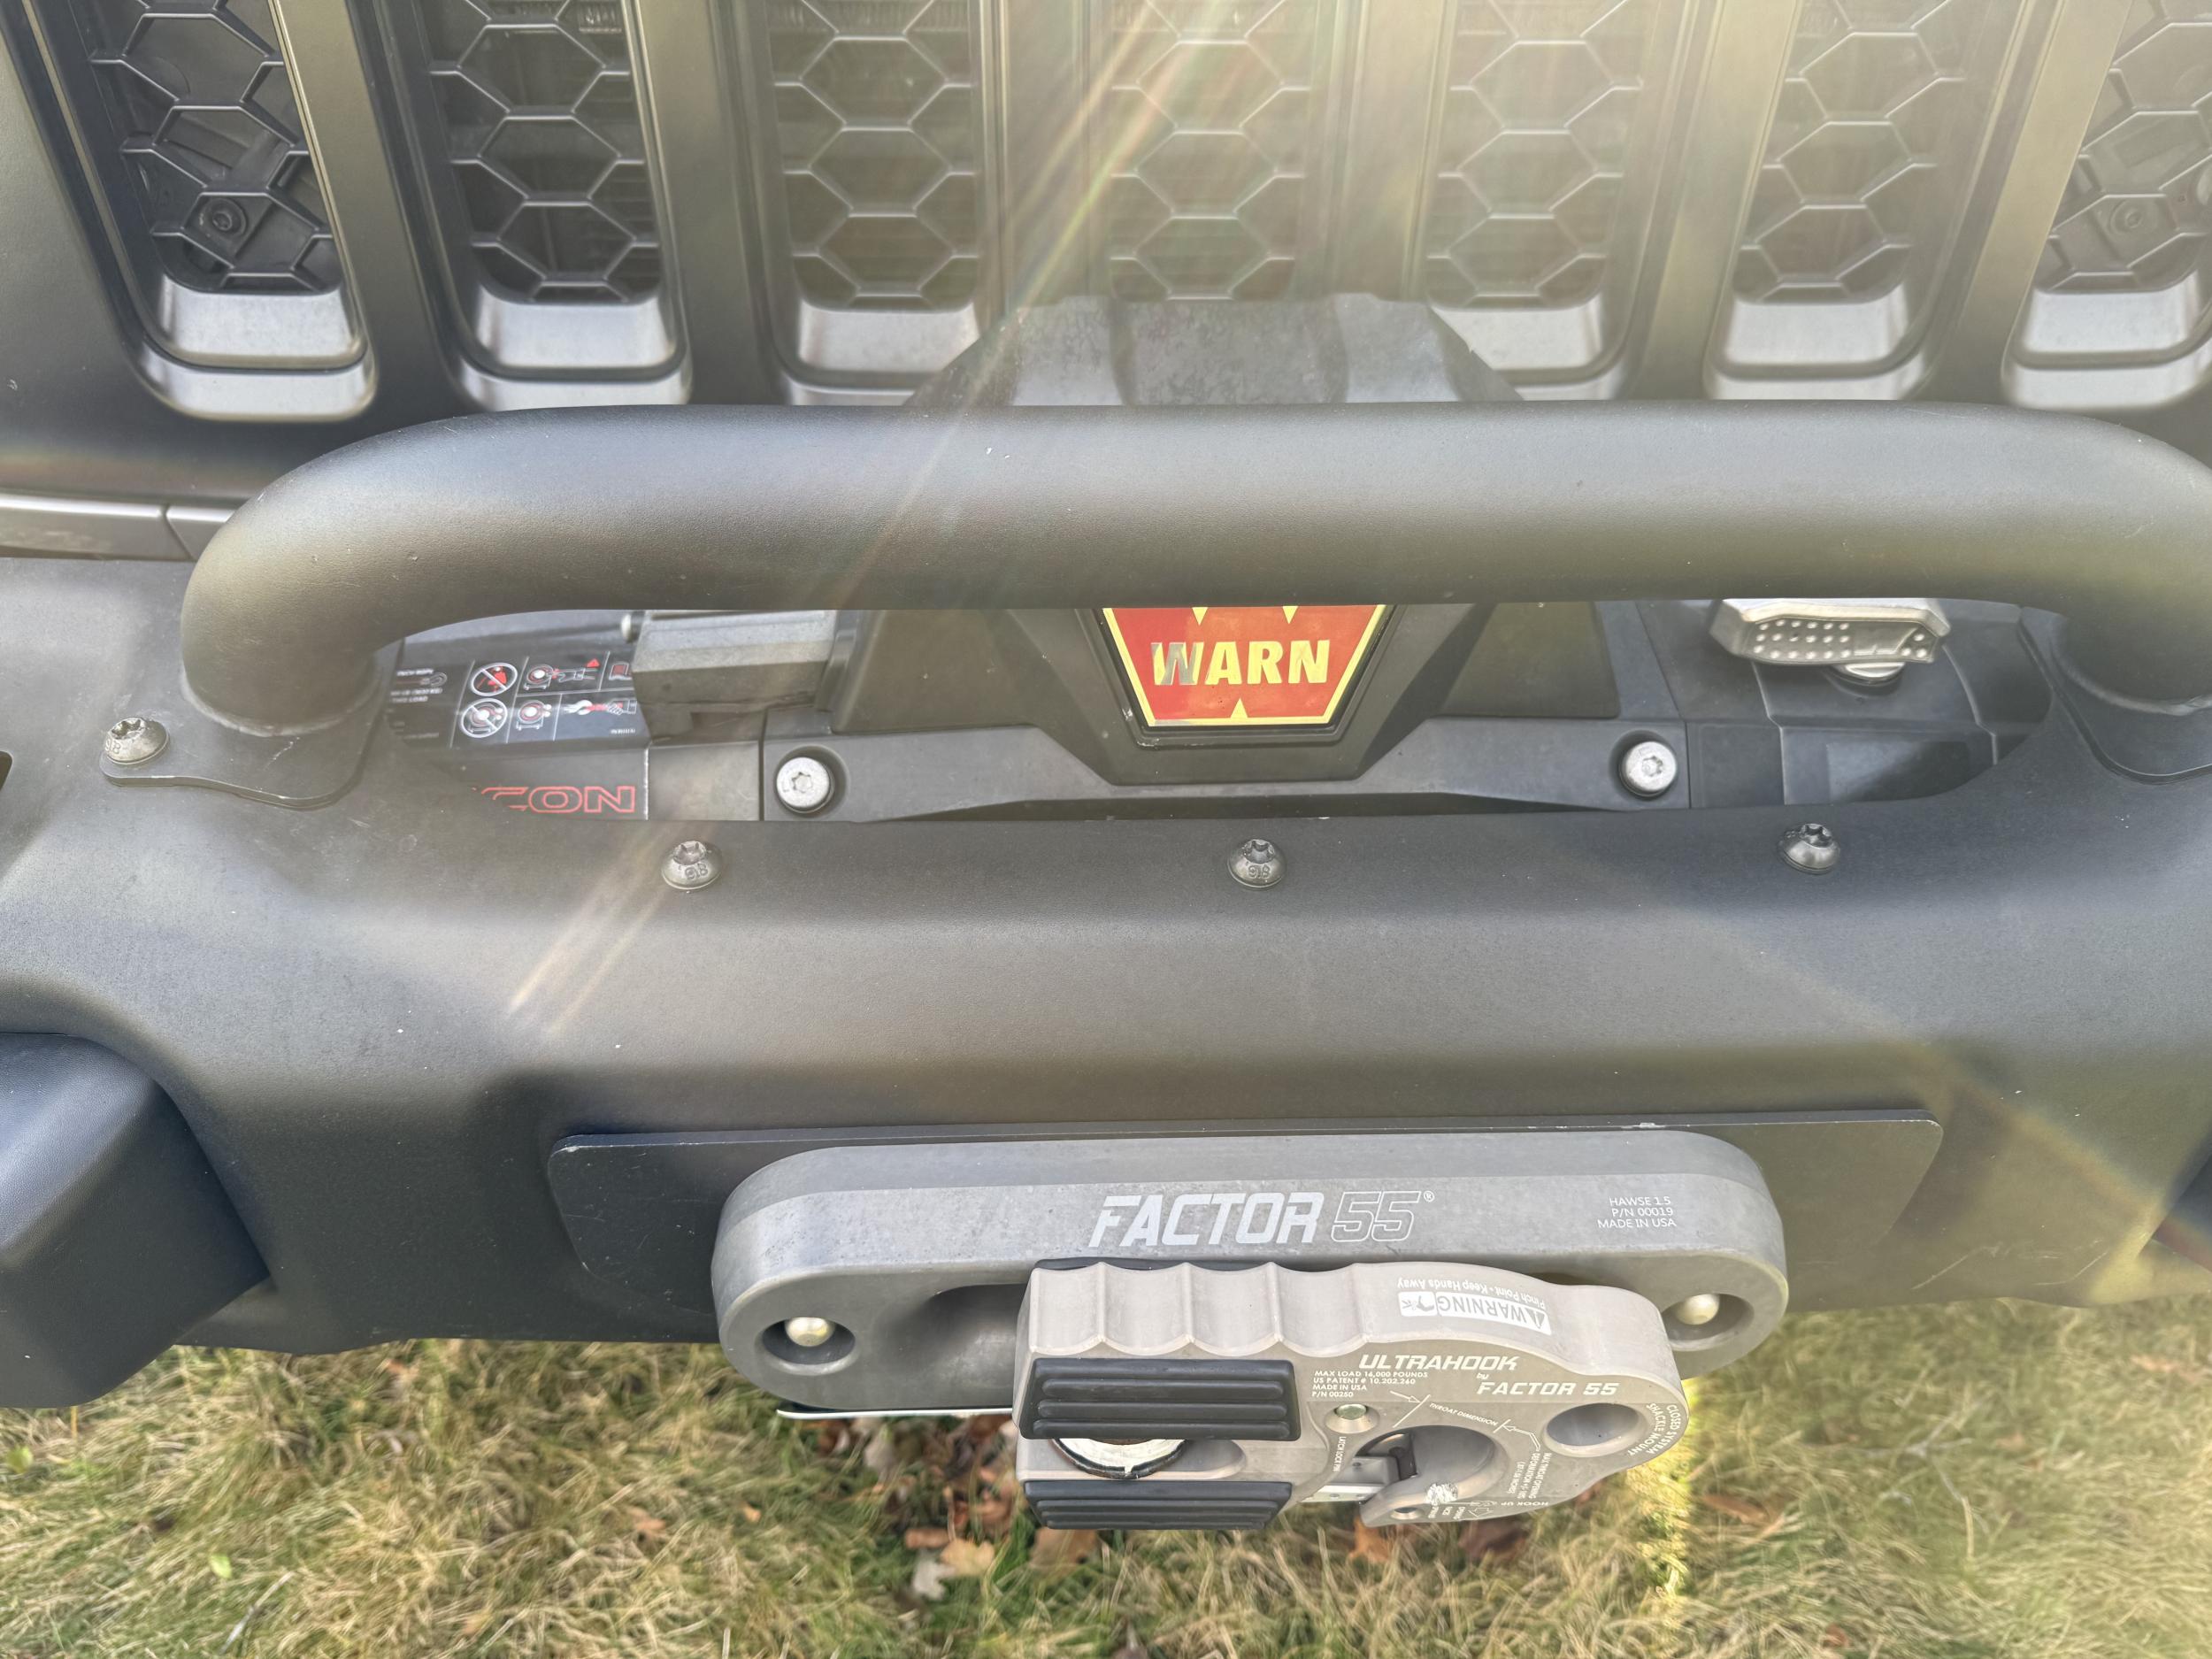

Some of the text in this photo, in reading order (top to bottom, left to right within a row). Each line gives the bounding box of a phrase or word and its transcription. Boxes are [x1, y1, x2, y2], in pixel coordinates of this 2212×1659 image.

[1150, 640, 1331, 686] WARN
[1609, 1196, 1652, 1206] HAWSE
[1611, 1207, 1674, 1217] P/N 00019
[1088, 1192, 1325, 1248] FACTOR
[1597, 1217, 1677, 1228] MADE IN USA
[1397, 1277, 1426, 1289] Away
[1427, 1279, 1462, 1291] Hands
[1462, 1279, 1489, 1294] Keep
[1494, 1286, 1520, 1302] Point
[1521, 1292, 1547, 1310] Pinch
[1436, 1294, 1528, 1324] WARNING
[1358, 1355, 1521, 1371] ULTRAHOOK
[1476, 1372, 1490, 1381] by
[1477, 1382, 1620, 1395] FACTOR 55
[1627, 1402, 1666, 1456] SHACKLE MOUNT
[1646, 1404, 1681, 1454] CLOSED SYSTEM
